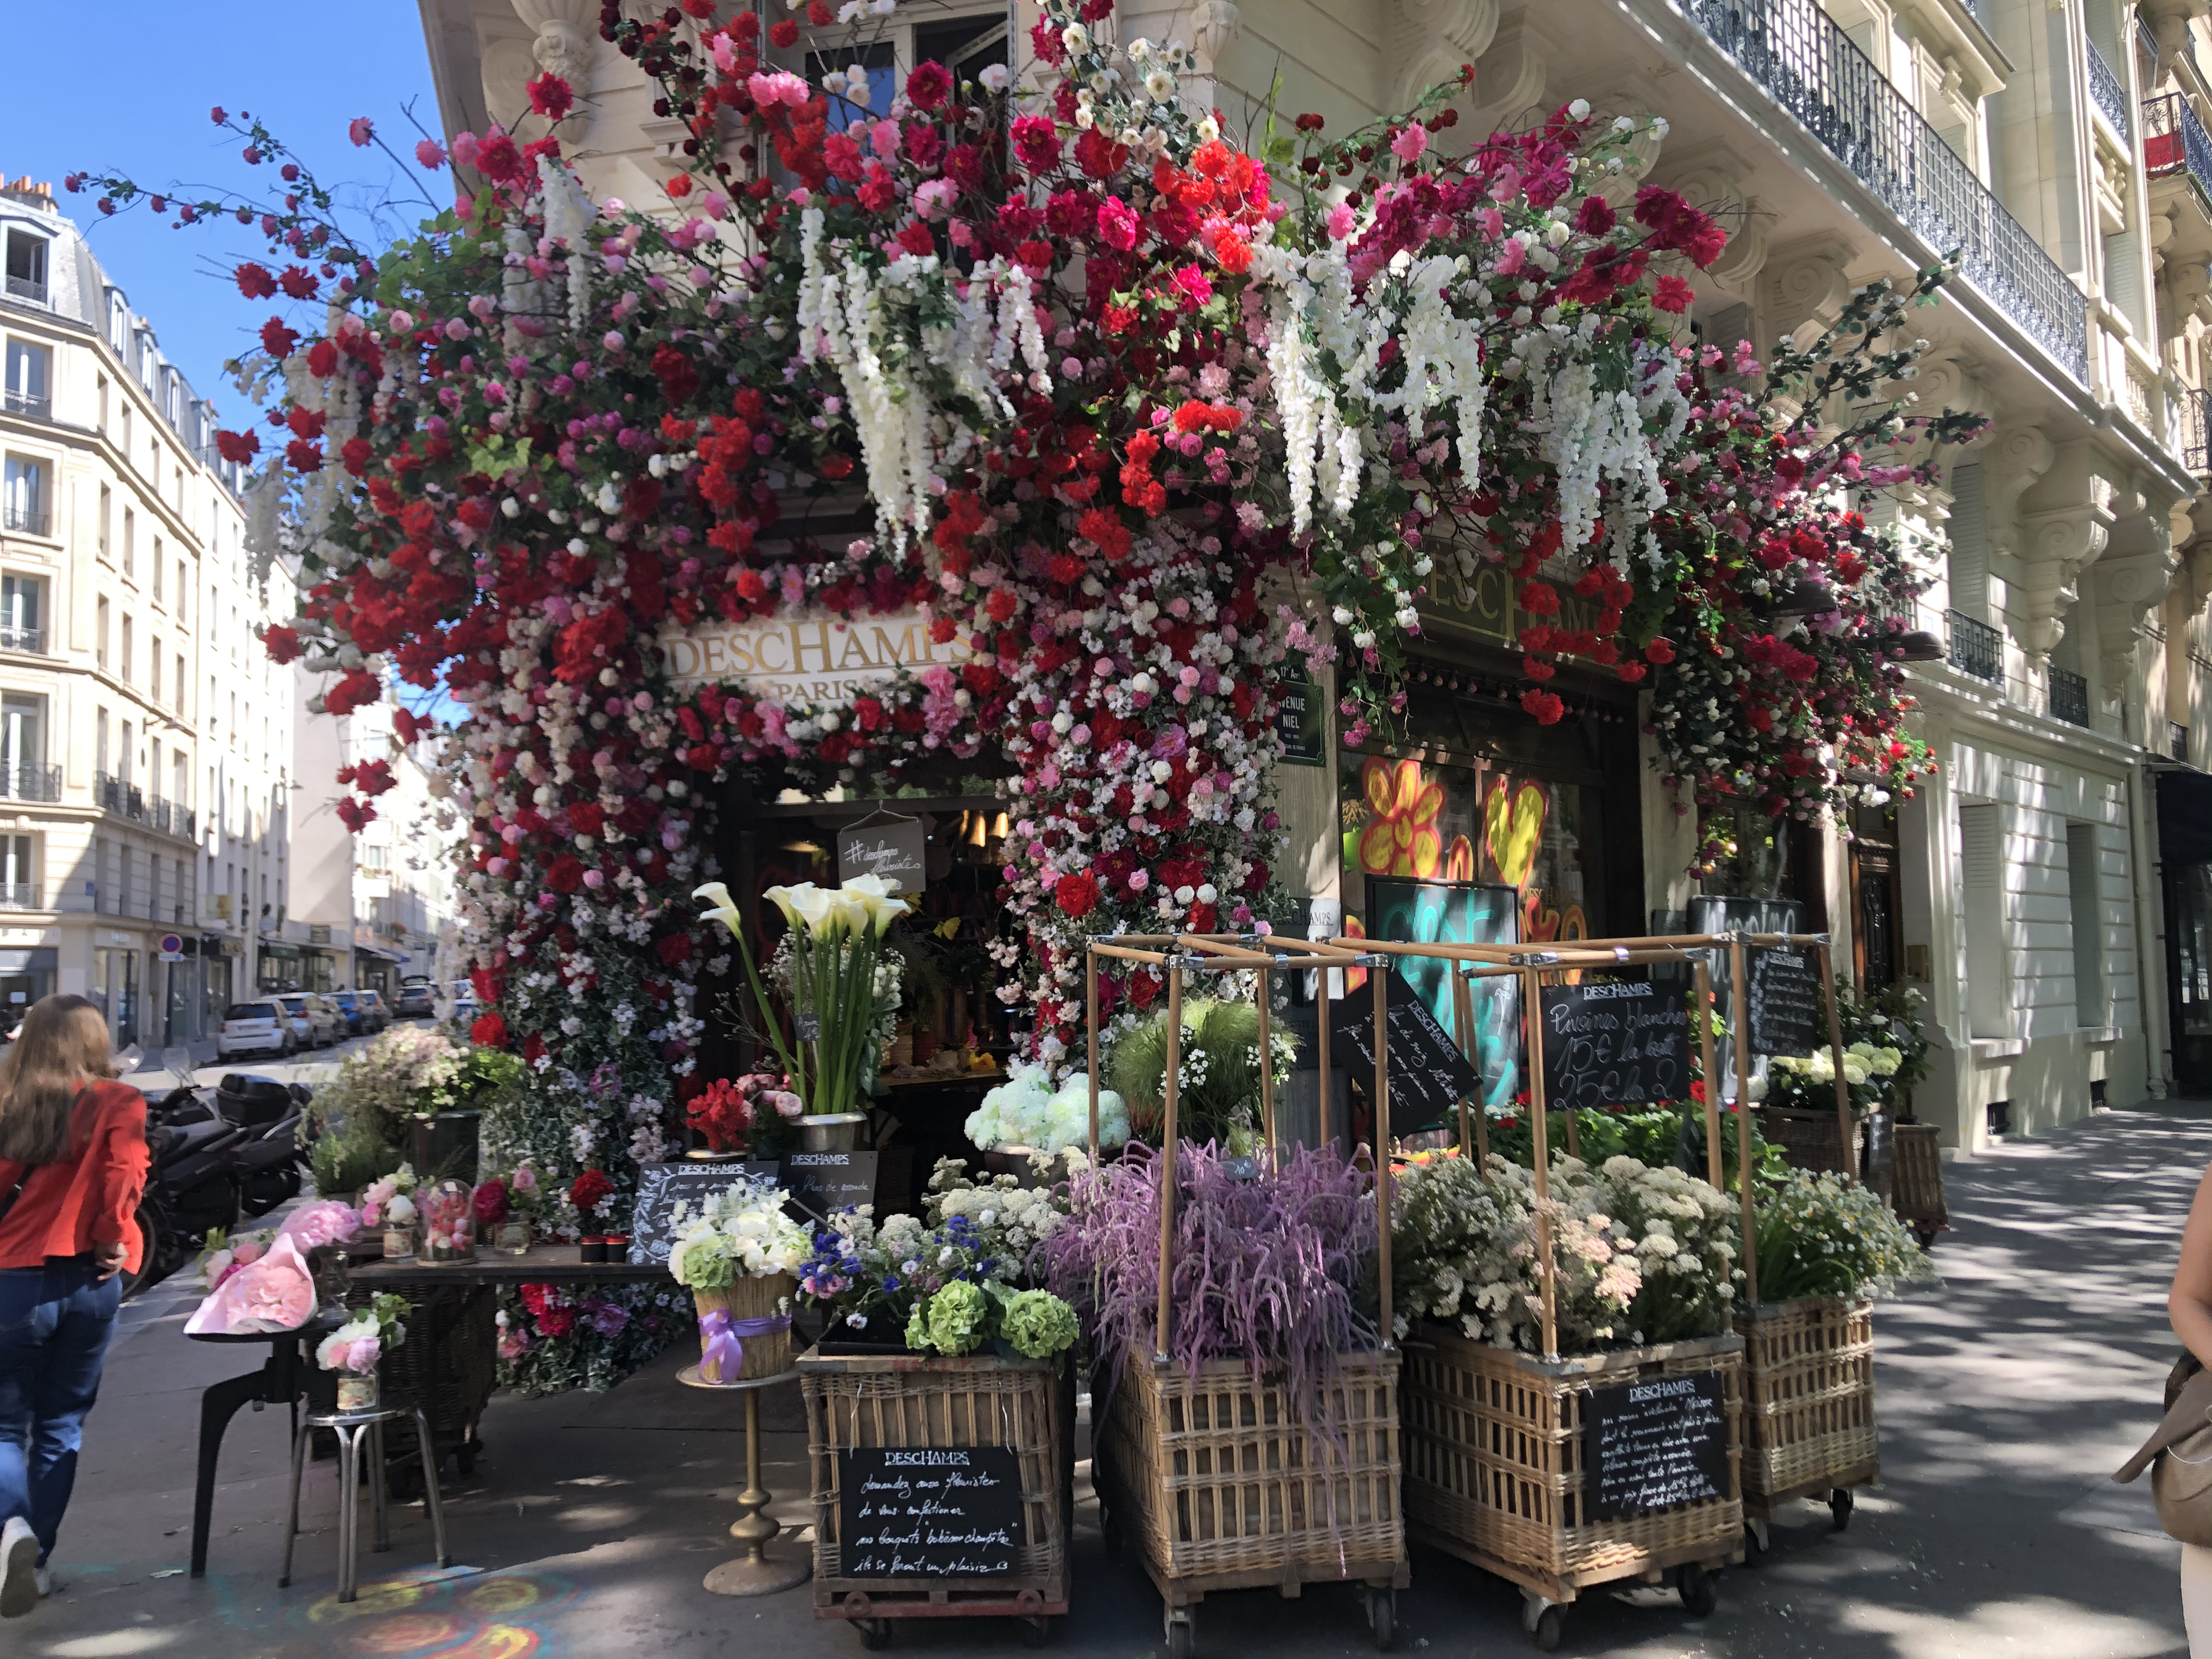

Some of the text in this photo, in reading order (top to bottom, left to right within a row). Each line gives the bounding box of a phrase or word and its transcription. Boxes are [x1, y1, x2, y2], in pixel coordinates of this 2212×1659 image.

[775, 678, 858, 702] PARIS
[1282, 714, 1300, 729] NIEL
[1584, 982, 1654, 1000] DESCHAMPS
[1407, 1000, 1459, 1063] DESCHAMPS
[1617, 1031, 1640, 1062] la
[1651, 1058, 1678, 1099] 2
[791, 1154, 849, 1165] DESCHAMPS
[678, 1163, 745, 1176] DESCHAMPS
[1629, 1379, 1695, 1403] DESCHAMPS
[884, 1451, 970, 1466] DESCHAMPS
[858, 1501, 872, 1518] de
